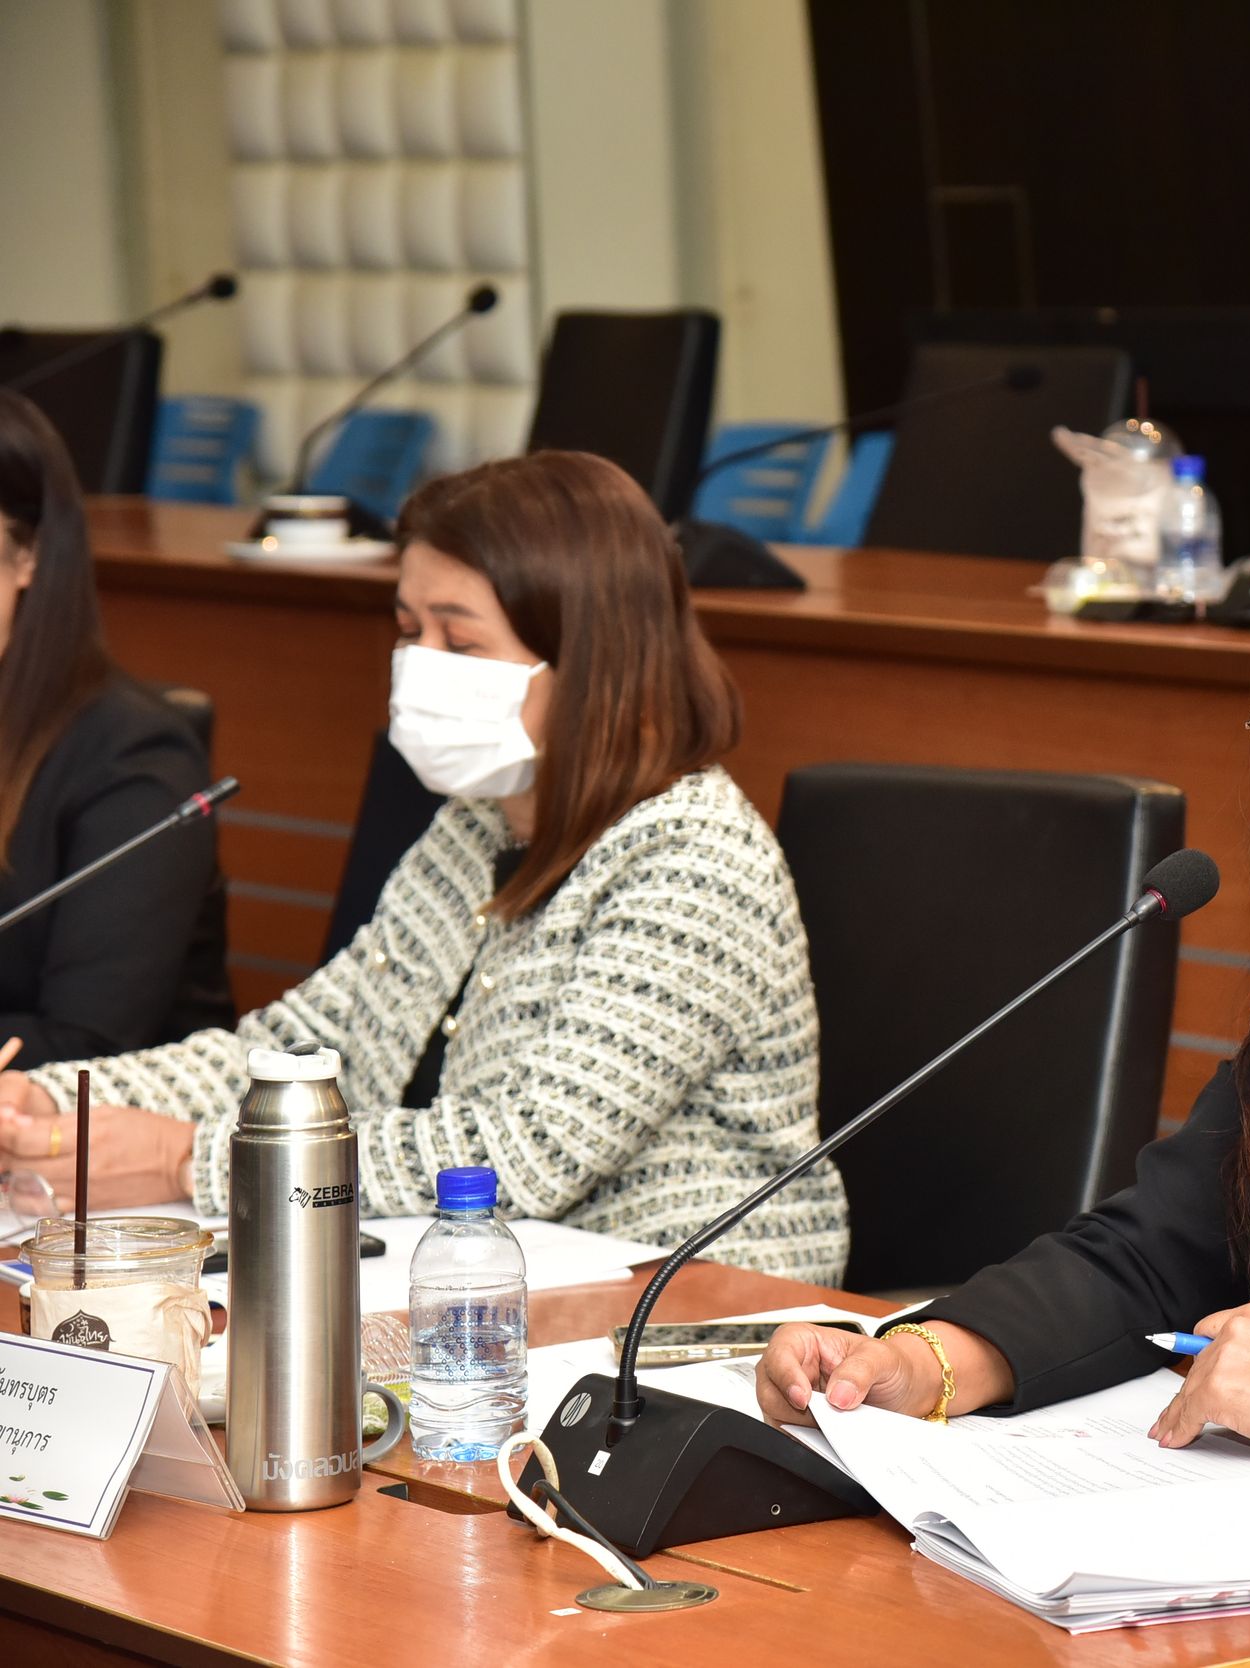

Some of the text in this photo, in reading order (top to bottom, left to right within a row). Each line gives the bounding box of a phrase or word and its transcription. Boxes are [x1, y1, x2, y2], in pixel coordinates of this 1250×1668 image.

[312, 1183, 354, 1200] ZEBRA
[0, 1367, 58, 1411] ันทรบุตร
